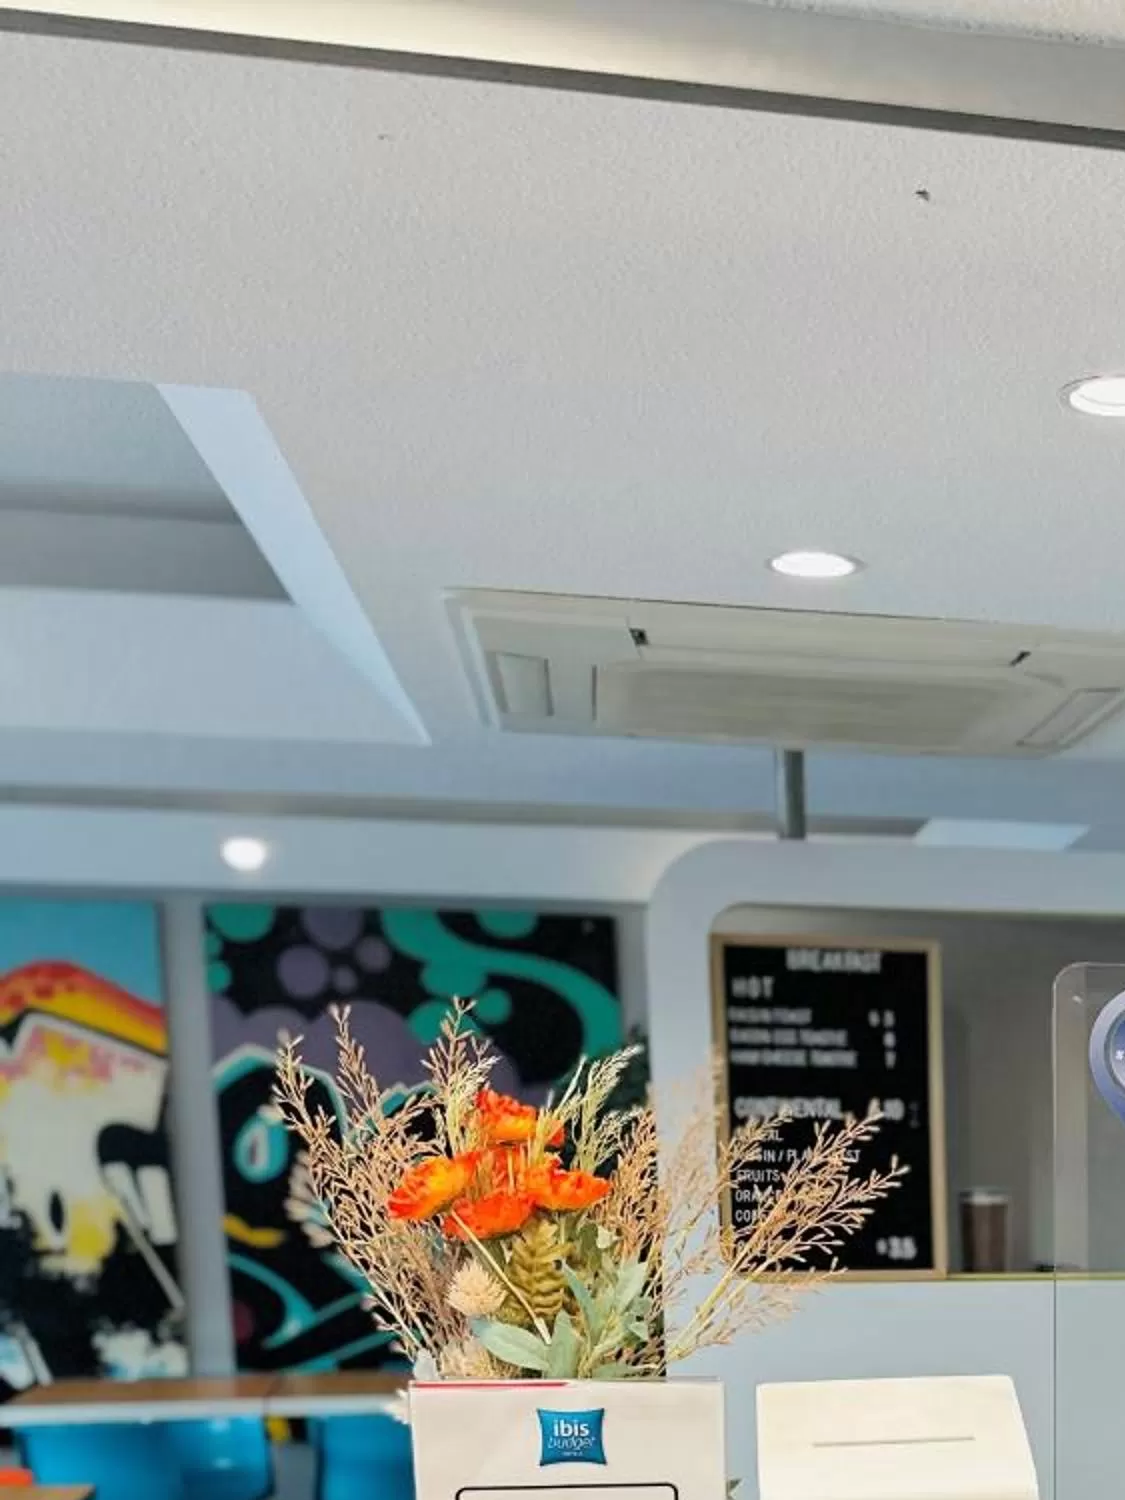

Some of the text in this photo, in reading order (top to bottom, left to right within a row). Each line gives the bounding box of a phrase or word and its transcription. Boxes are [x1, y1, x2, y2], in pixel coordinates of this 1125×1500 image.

[732, 975, 774, 999] HOT
[553, 1419, 590, 1437] ibis
[547, 1436, 597, 1451] budget
